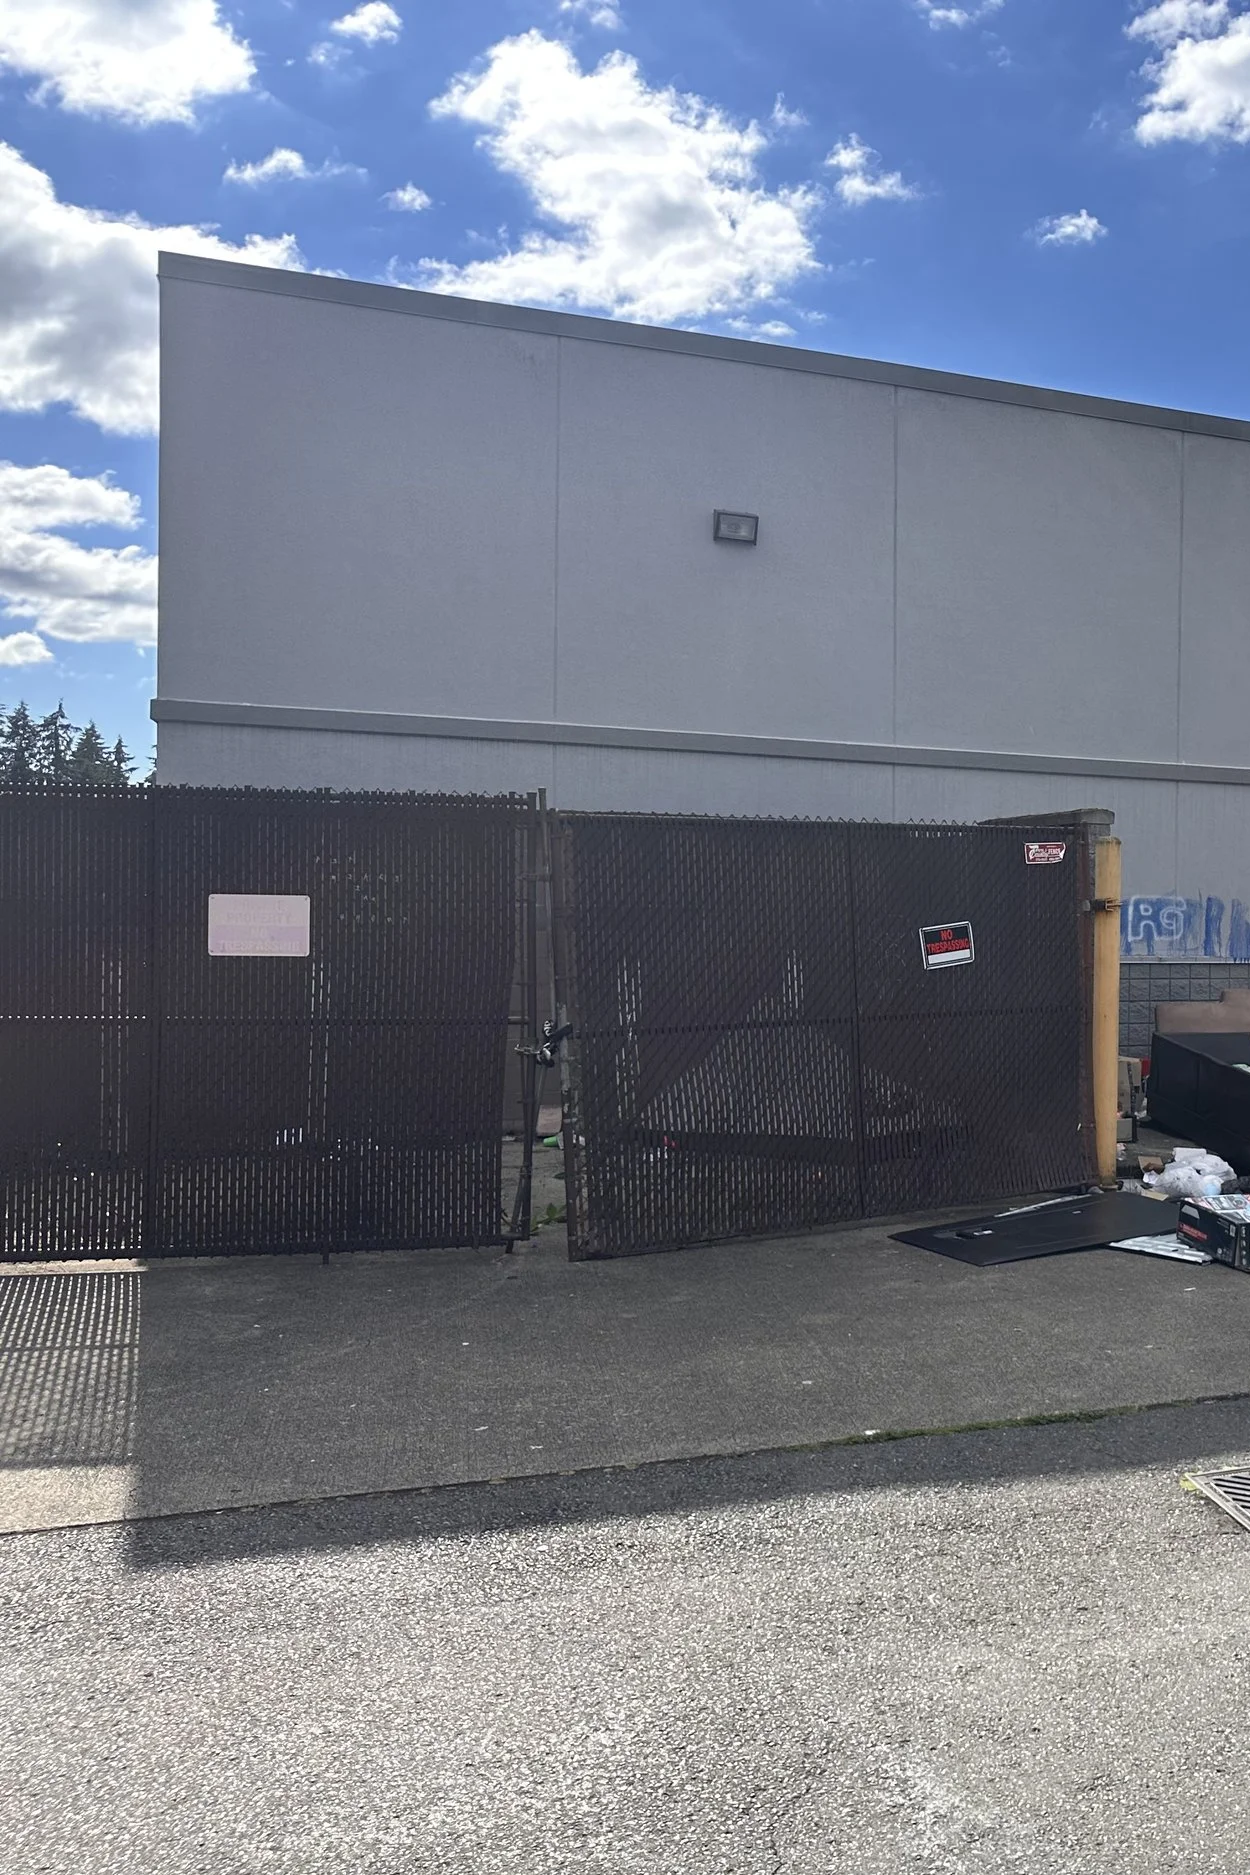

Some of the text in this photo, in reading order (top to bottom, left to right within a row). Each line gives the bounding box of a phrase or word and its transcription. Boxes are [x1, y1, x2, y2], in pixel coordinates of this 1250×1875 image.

[226, 912, 293, 924] PROPERTY
[250, 927, 269, 939] NO
[940, 929, 953, 941] NO
[217, 939, 302, 952] TRESPASSING
[926, 938, 970, 954] TRESPASSING
